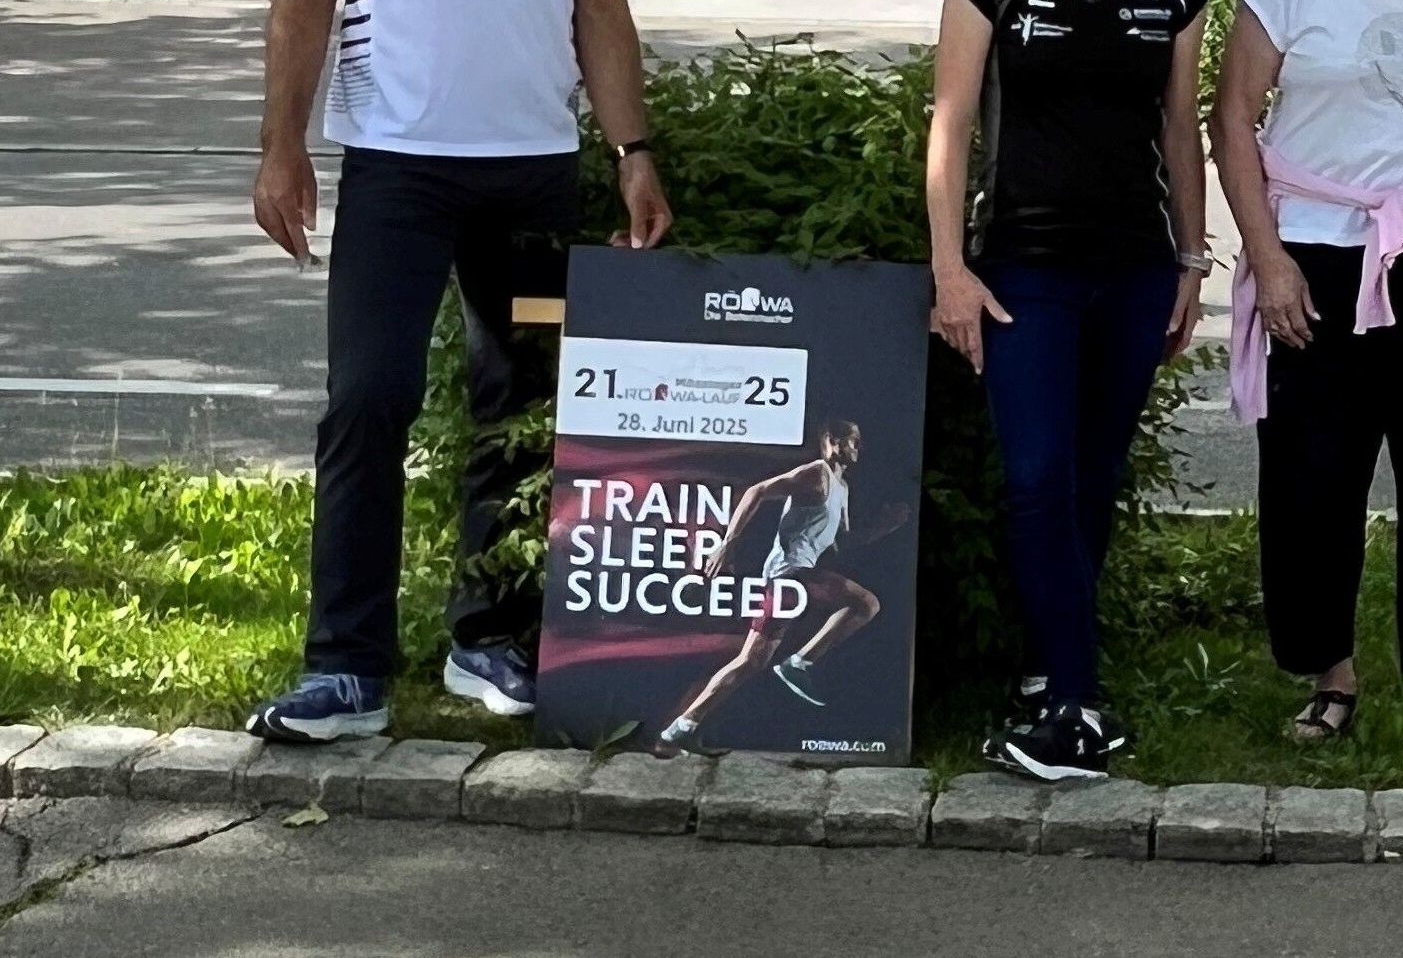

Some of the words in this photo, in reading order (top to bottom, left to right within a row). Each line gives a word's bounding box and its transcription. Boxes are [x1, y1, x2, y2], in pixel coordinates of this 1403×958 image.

[744, 376, 791, 407] 25
[618, 413, 646, 432] 28.
[652, 415, 694, 433] Juni
[701, 418, 747, 436] 2025
[573, 479, 733, 526] TRAIN
[568, 525, 728, 572] SLEEP
[565, 570, 808, 619] SUCCEED
